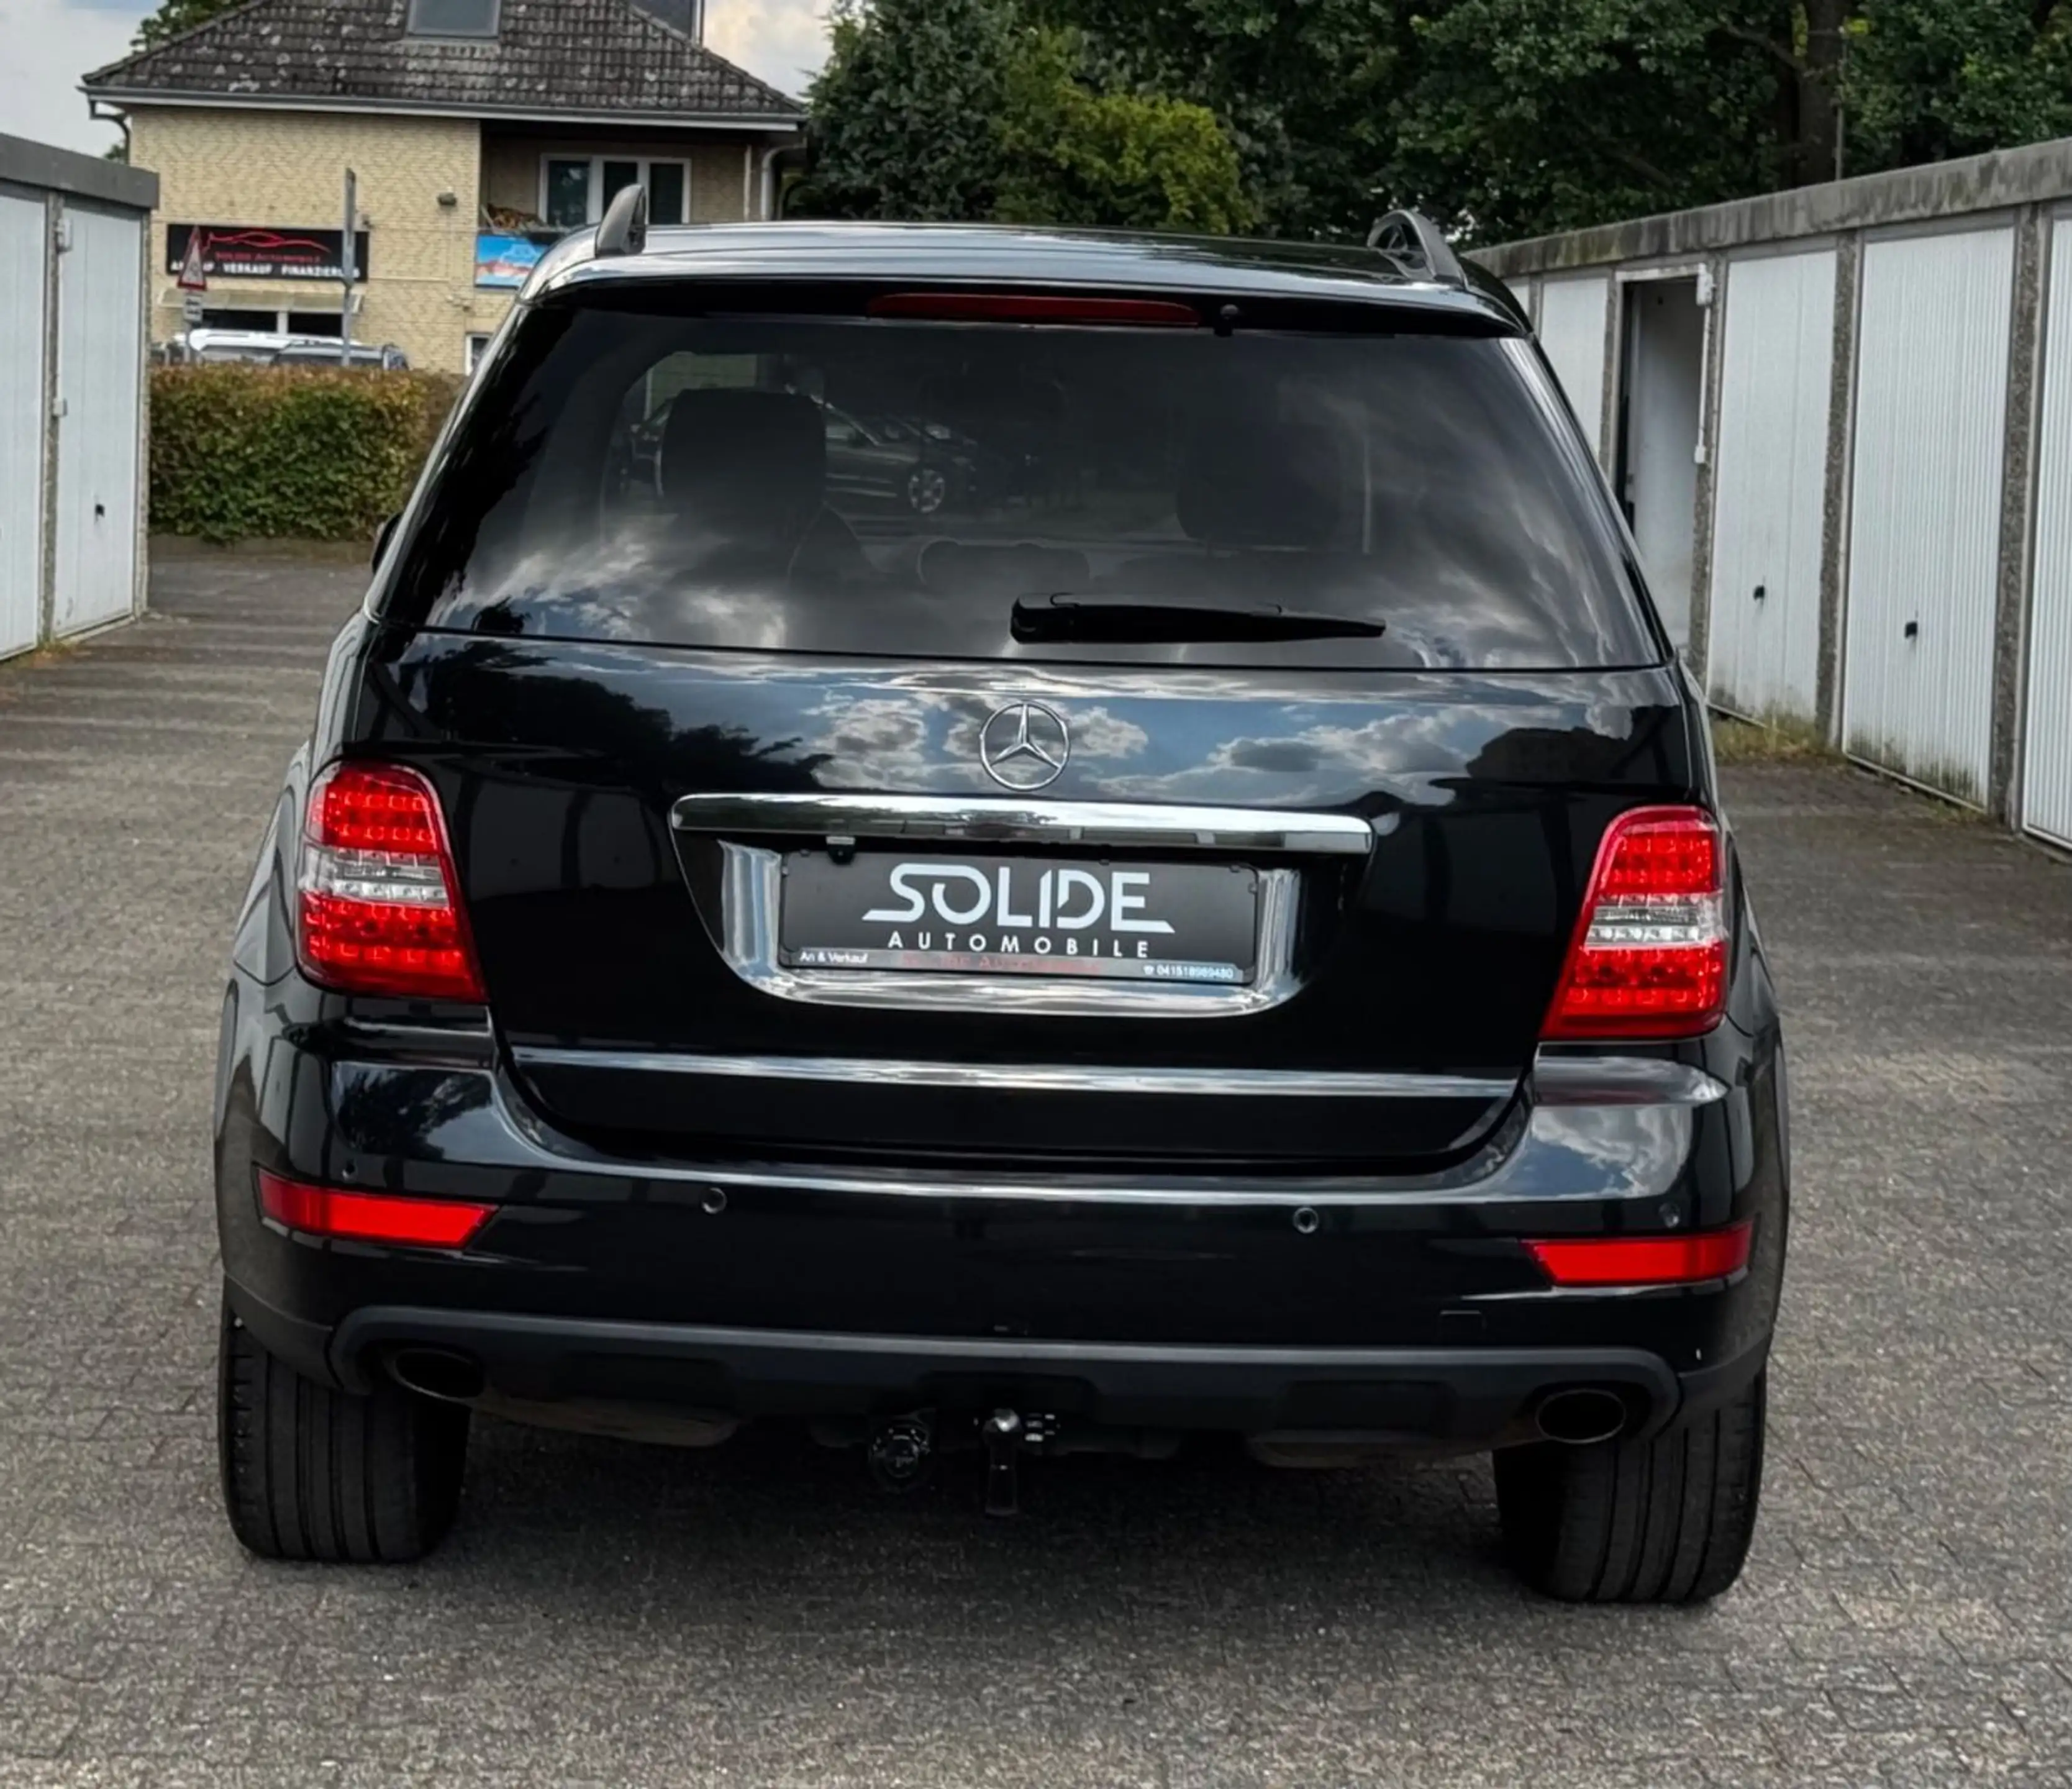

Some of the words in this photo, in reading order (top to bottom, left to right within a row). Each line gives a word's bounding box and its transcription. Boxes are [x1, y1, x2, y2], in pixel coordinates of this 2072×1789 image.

[223, 262, 272, 274] VERKAUF
[862, 863, 1175, 934] SOLIDE
[888, 931, 1148, 958] AUTOMOBILE
[800, 951, 815, 962] An
[817, 952, 826, 962] &
[828, 952, 868, 964] Verkauf
